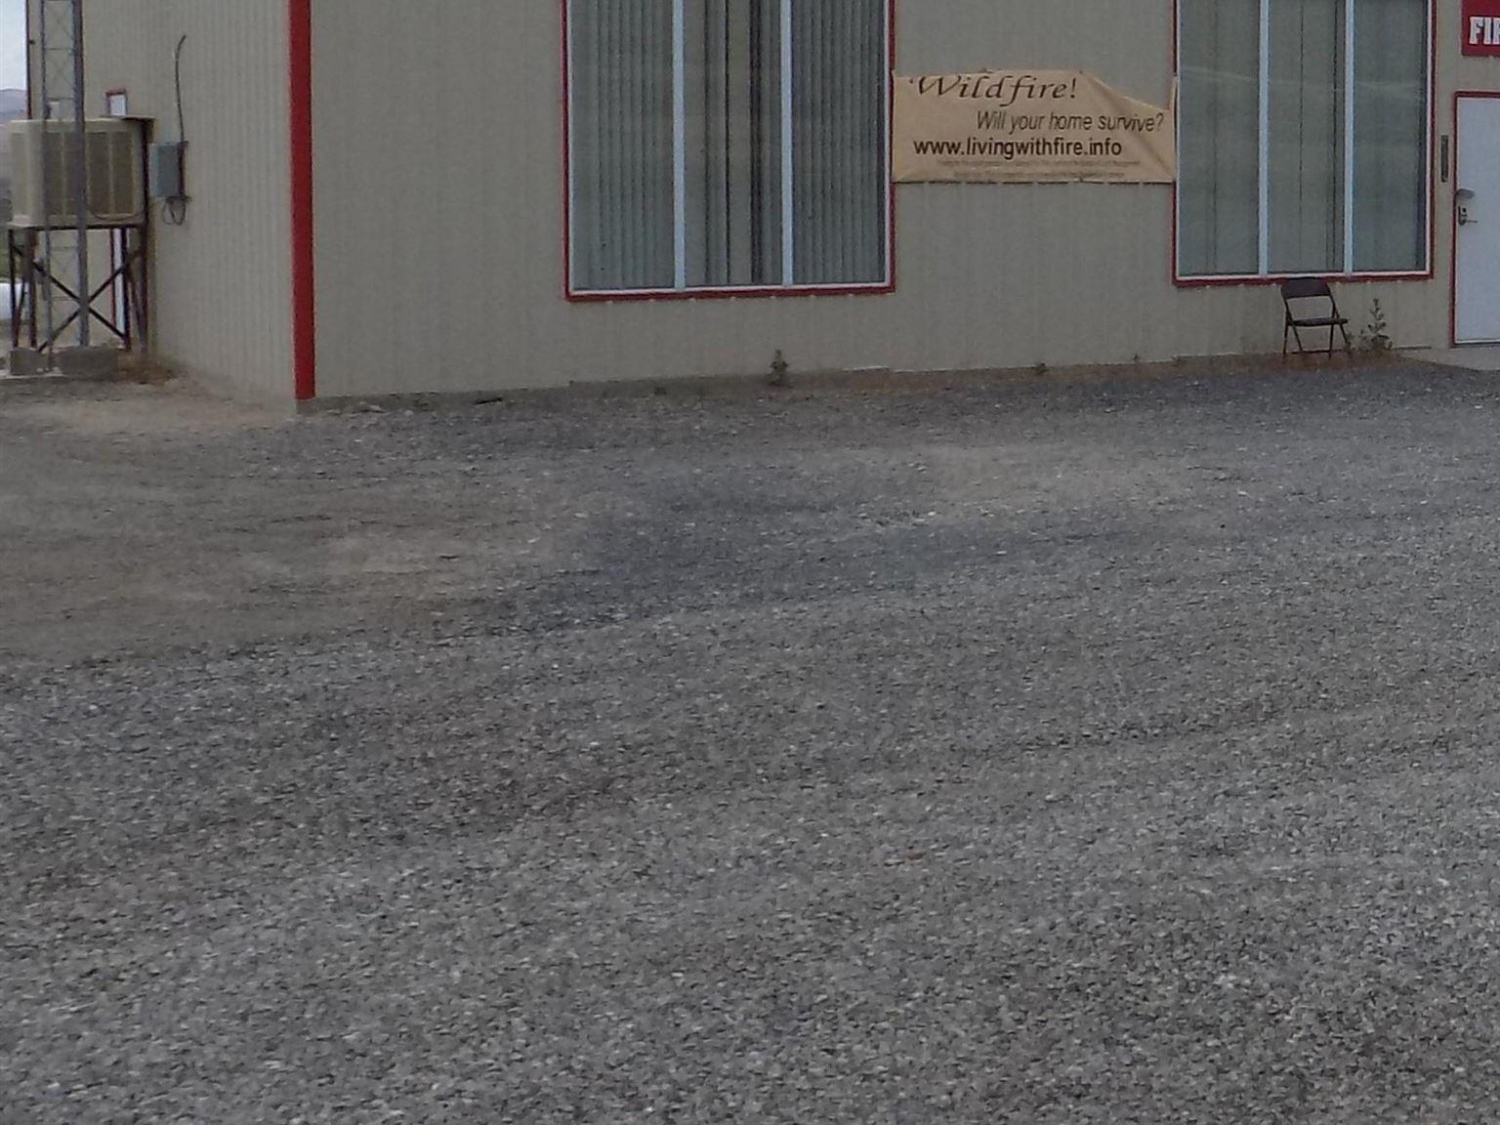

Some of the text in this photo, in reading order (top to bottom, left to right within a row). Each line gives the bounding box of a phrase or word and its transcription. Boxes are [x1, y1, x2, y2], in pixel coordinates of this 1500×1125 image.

[909, 74, 1077, 107] Wildfire!
[976, 110, 1164, 135] Will your home survive?
[913, 137, 1122, 160] www.livingwithfire.info
